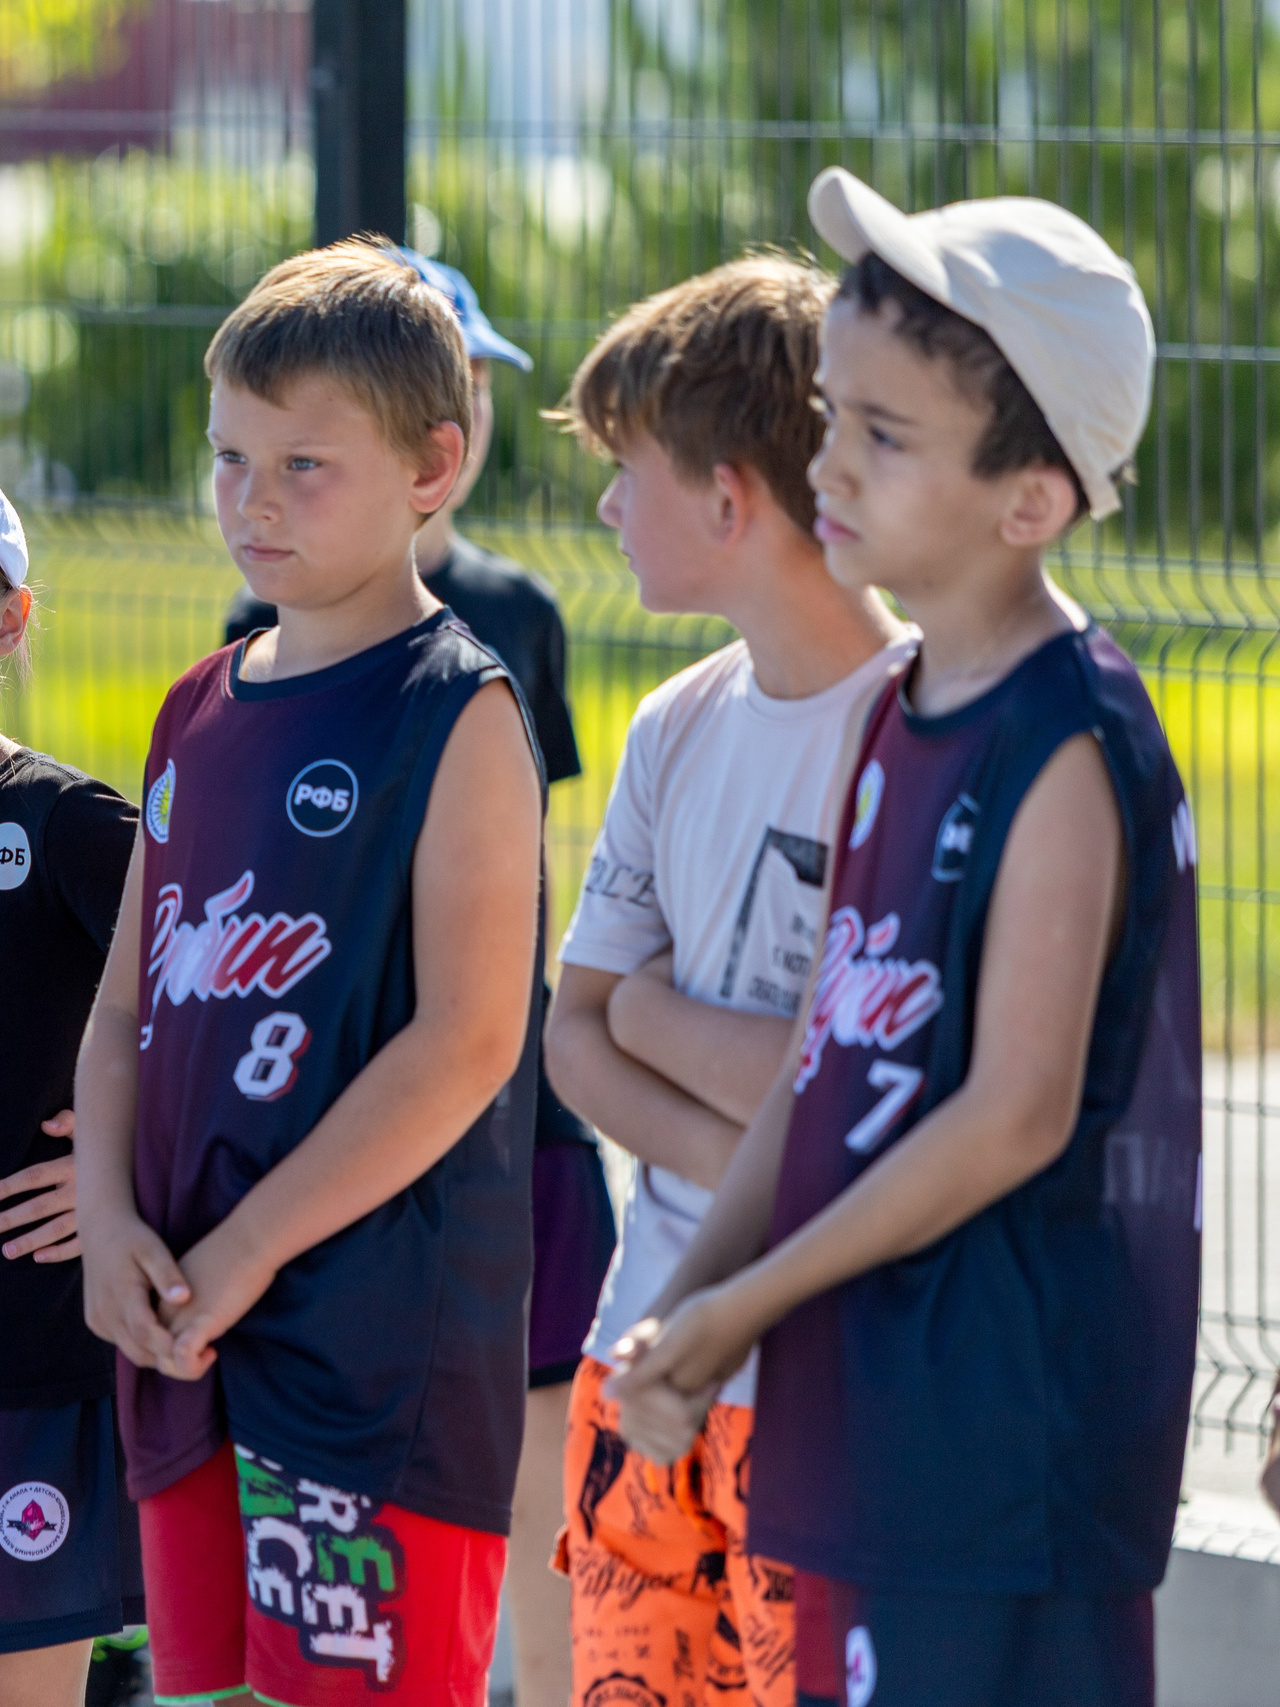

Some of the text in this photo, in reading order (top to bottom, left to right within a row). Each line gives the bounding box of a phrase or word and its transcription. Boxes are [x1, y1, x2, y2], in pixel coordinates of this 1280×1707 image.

[293, 783, 350, 812] РФБ
[233, 1011, 311, 1101] 8
[845, 1058, 924, 1155] 7
[297, 1478, 396, 1684] REET
